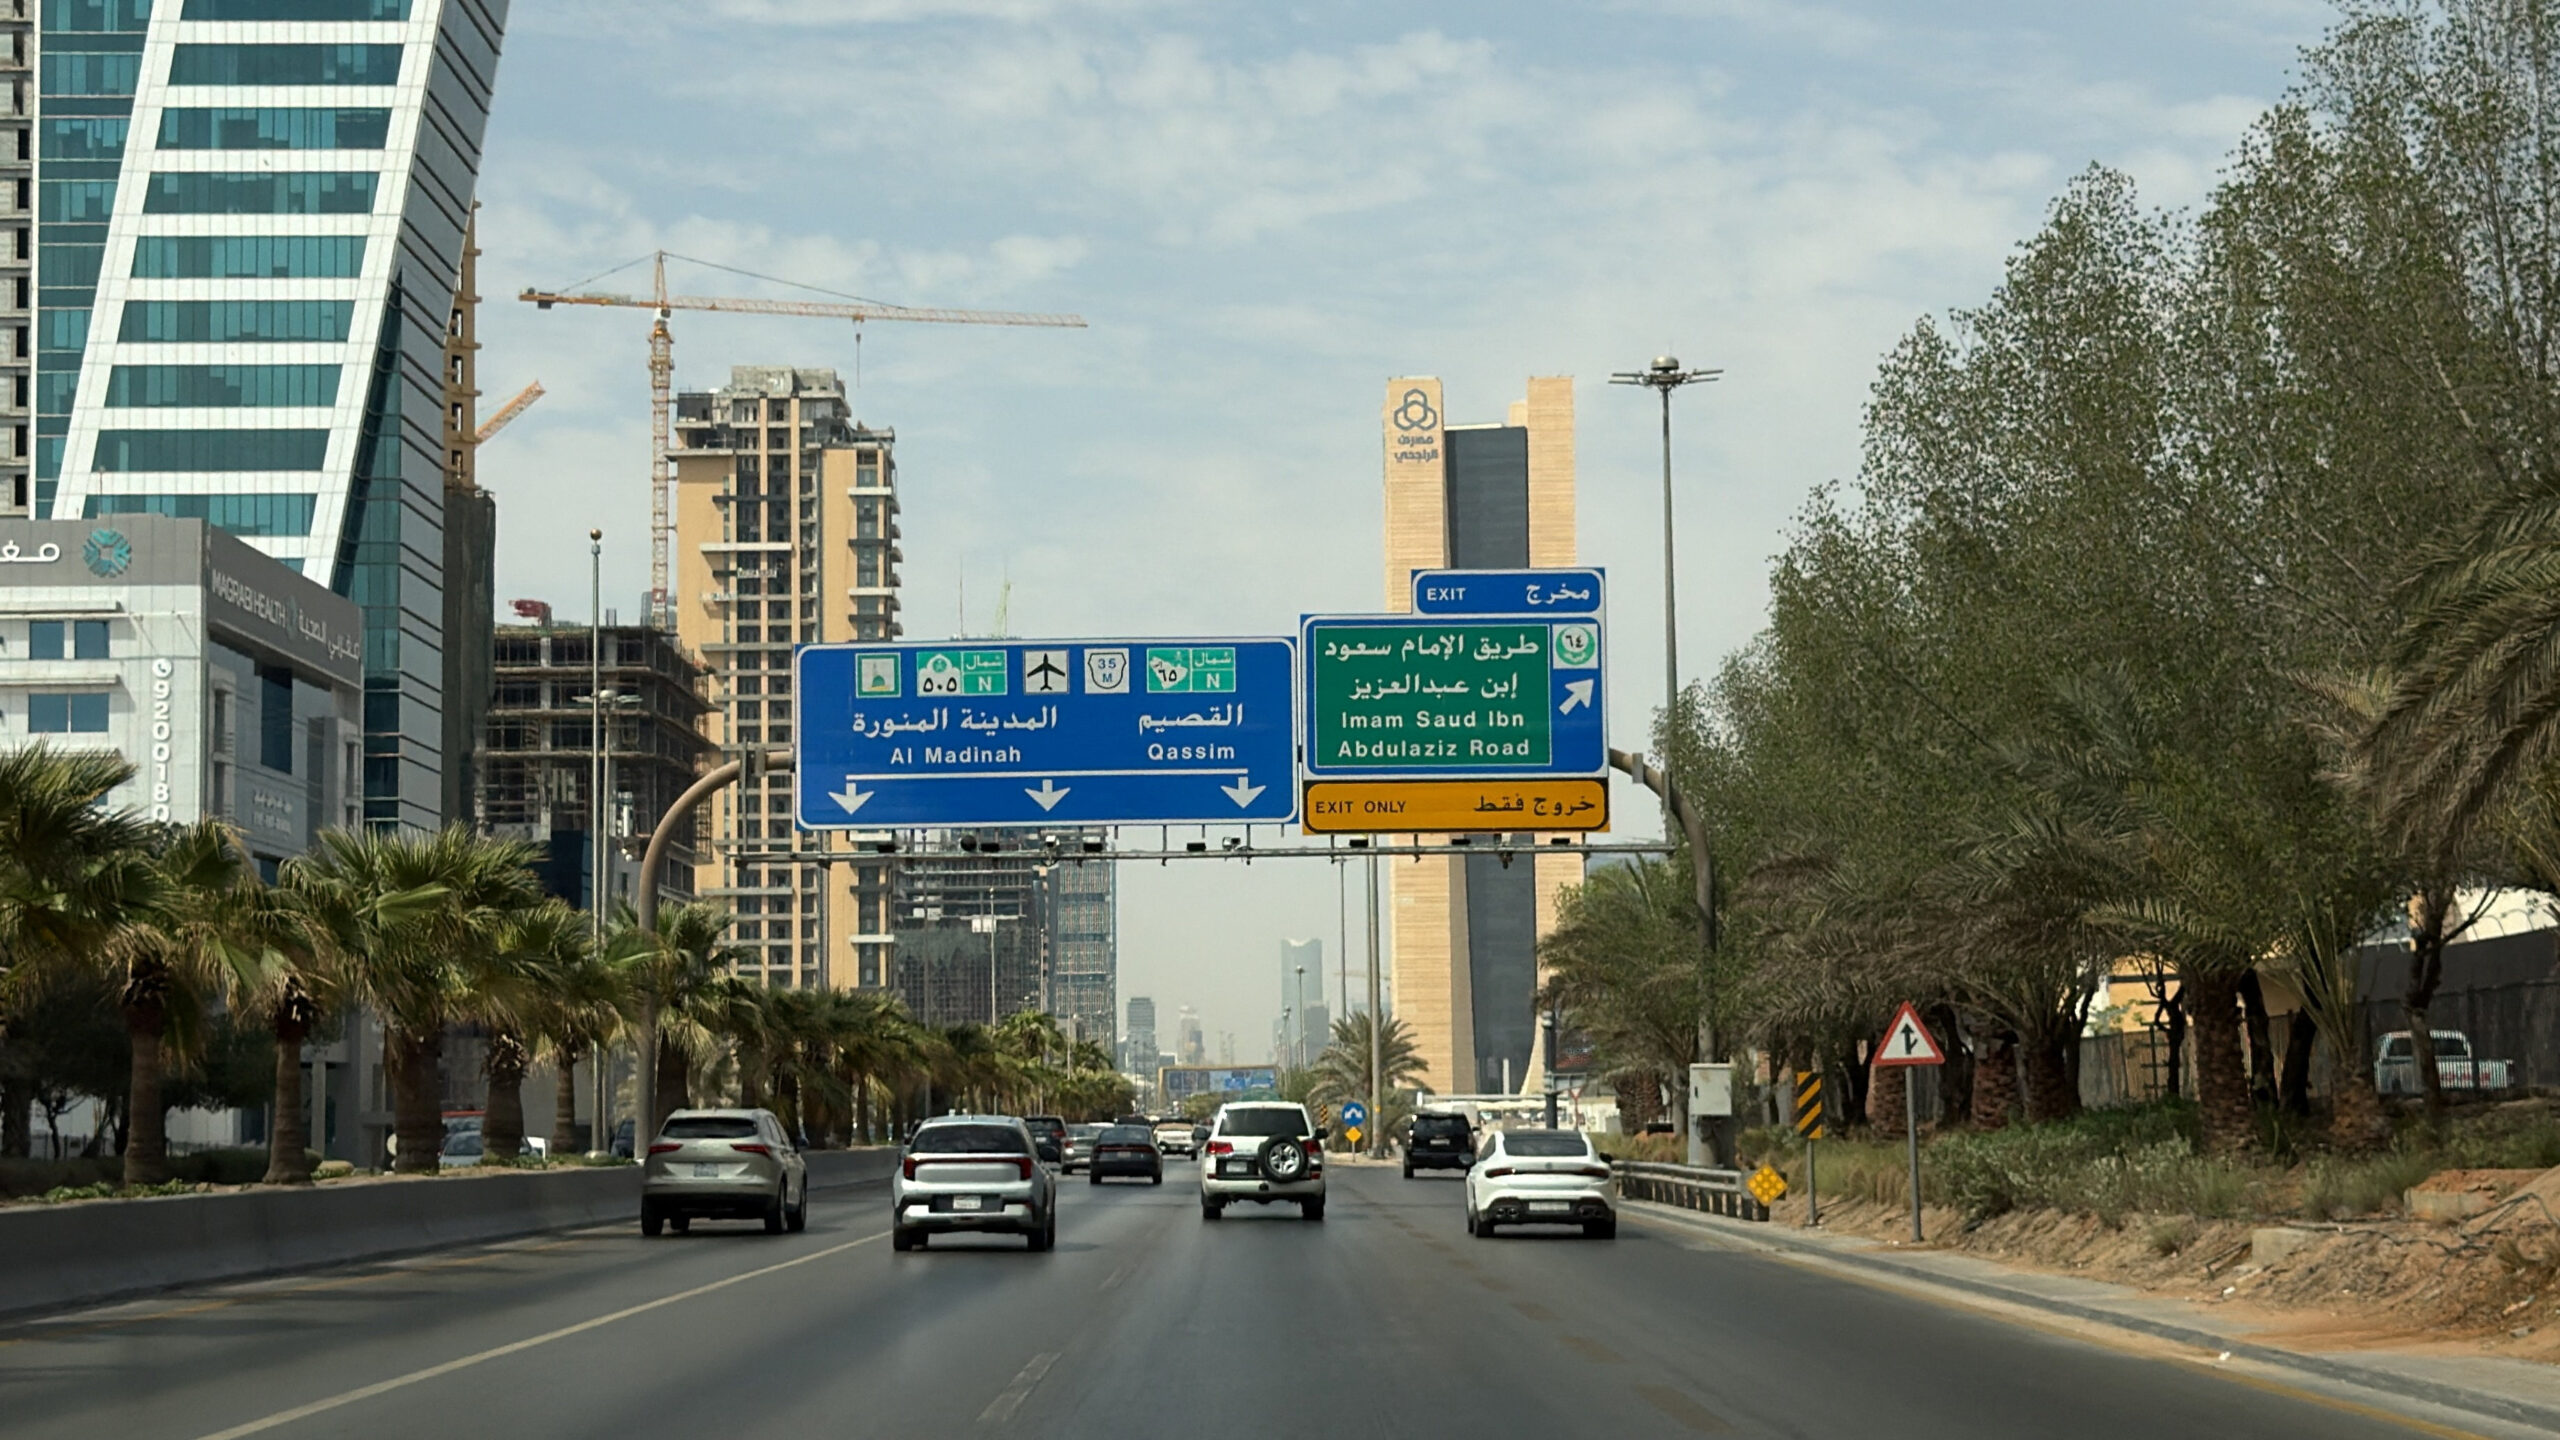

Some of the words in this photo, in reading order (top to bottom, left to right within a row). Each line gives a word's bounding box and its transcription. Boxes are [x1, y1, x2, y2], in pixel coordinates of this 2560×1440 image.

[212, 568, 253, 614] MAGRABI
[253, 590, 286, 629] HEALTH
[1427, 587, 1466, 601] EXIT
[1526, 583, 1591, 605] مخرج
[1325, 641, 1392, 661] سعود
[1401, 633, 1464, 662] الإمام
[1473, 633, 1539, 661] طريق
[966, 655, 1003, 670] شمال
[1098, 658, 1117, 669] 35
[1194, 651, 1231, 667] شمال
[923, 677, 957, 692] ٥٠٥
[978, 676, 992, 692] N
[1102, 674, 1113, 683] M
[1158, 669, 1177, 682] ٦٥
[1206, 673, 1220, 689] N
[1480, 672, 1518, 699] إبن
[852, 707, 948, 738] المنورة
[960, 704, 1057, 736] المدينة
[1138, 703, 1243, 736] القصيم
[1342, 712, 1403, 729] Imam
[1416, 711, 1476, 728] Saud
[1488, 711, 1524, 728] Ibn
[890, 748, 912, 764] Al
[925, 746, 1021, 764] Madinah
[1147, 744, 1235, 760] Qassim
[1338, 740, 1457, 758] Abdulaziz
[1470, 738, 1529, 756] Road
[1315, 801, 1353, 814] EXIT
[1364, 800, 1407, 813] ONLY
[1473, 793, 1524, 812] فقط
[1533, 796, 1596, 816] خروج
